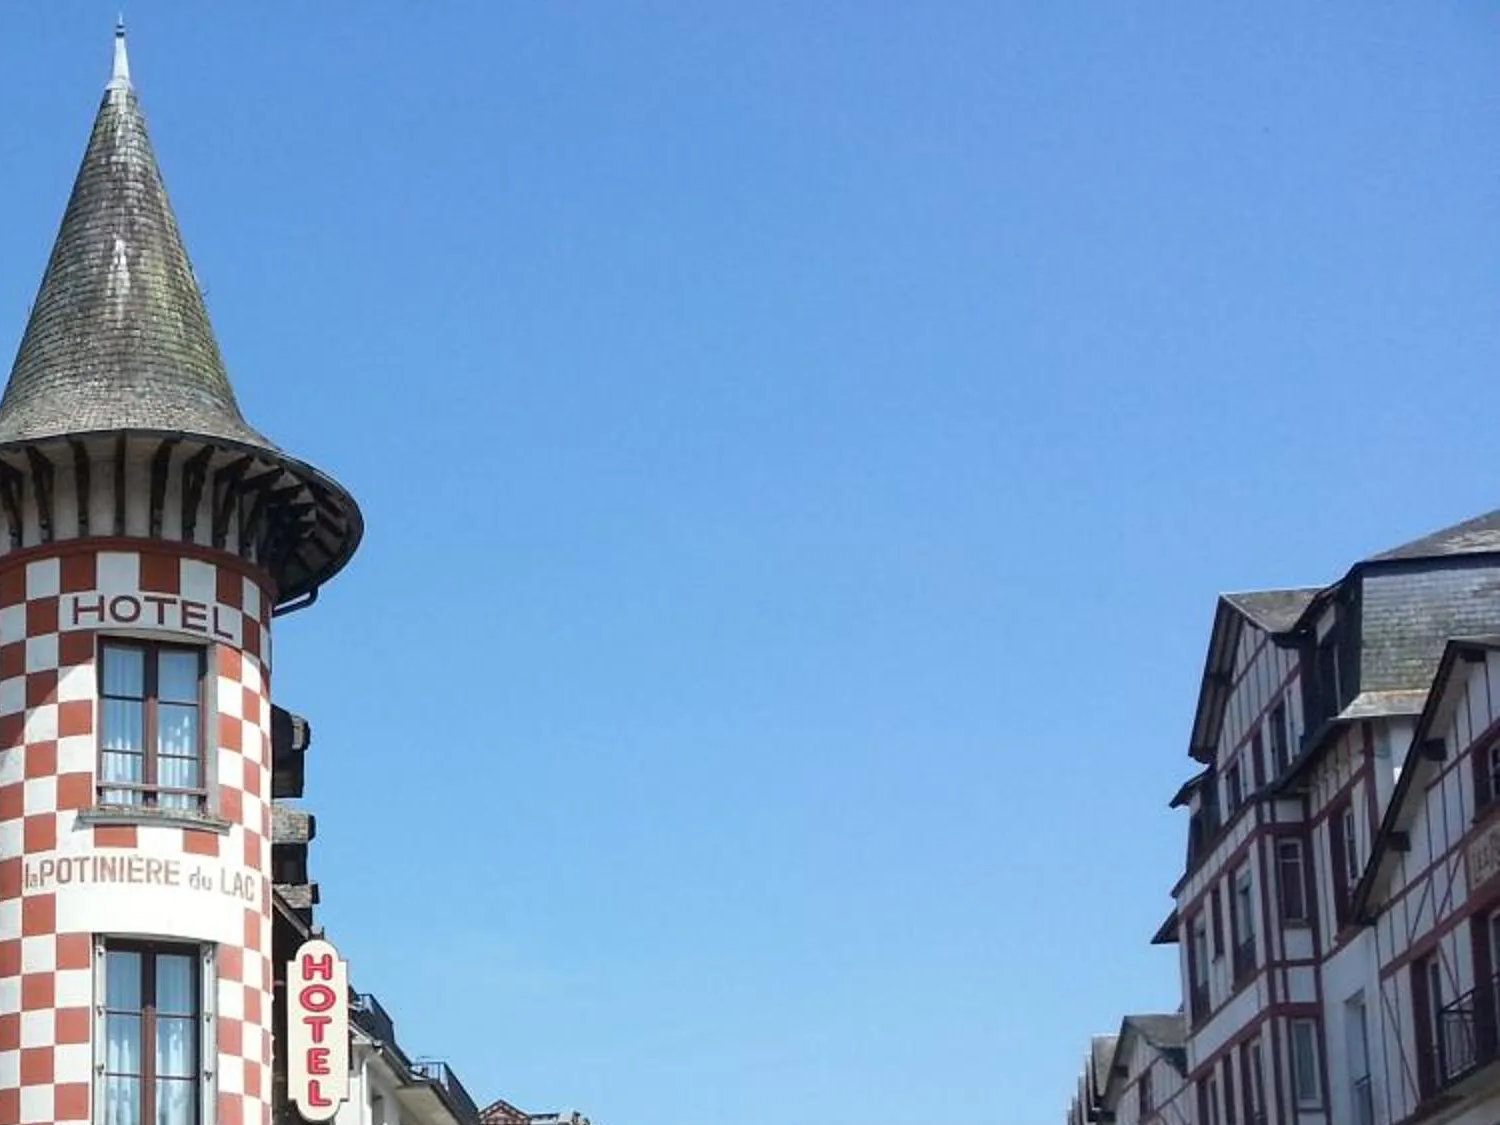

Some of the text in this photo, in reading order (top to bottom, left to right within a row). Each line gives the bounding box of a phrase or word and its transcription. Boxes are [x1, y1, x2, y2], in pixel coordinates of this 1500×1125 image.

[71, 594, 234, 641] HOTEL
[25, 853, 256, 903] la POTINIÈRE du LAC
[298, 953, 337, 1107] HOTEL
